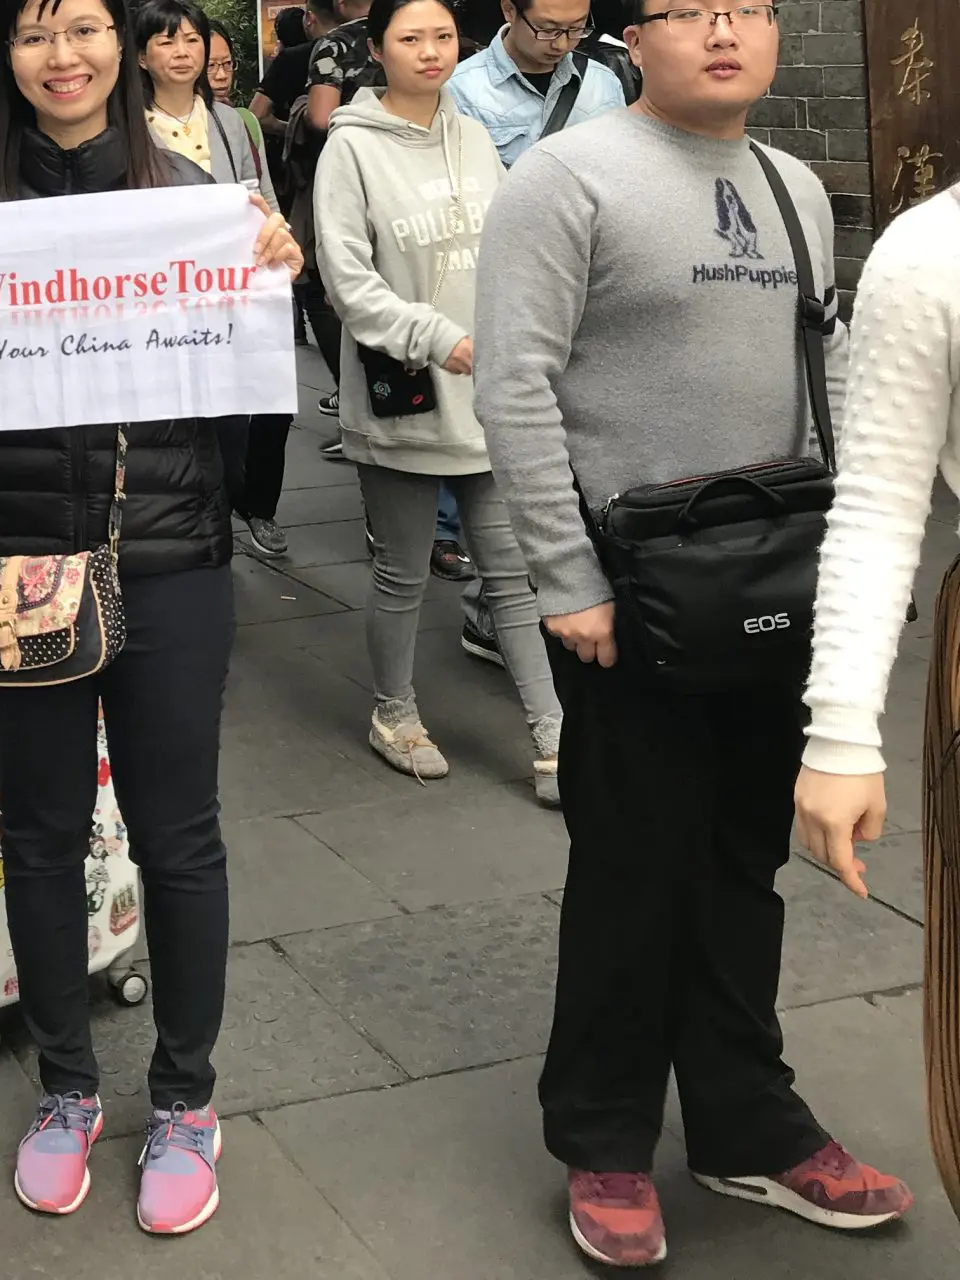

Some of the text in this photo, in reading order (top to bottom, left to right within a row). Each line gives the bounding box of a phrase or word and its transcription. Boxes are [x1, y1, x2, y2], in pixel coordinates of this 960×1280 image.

[692, 264, 798, 288] HushPuppie
[61, 333, 131, 356] China
[145, 323, 233, 350] Awaits!
[744, 612, 791, 634] EOS
